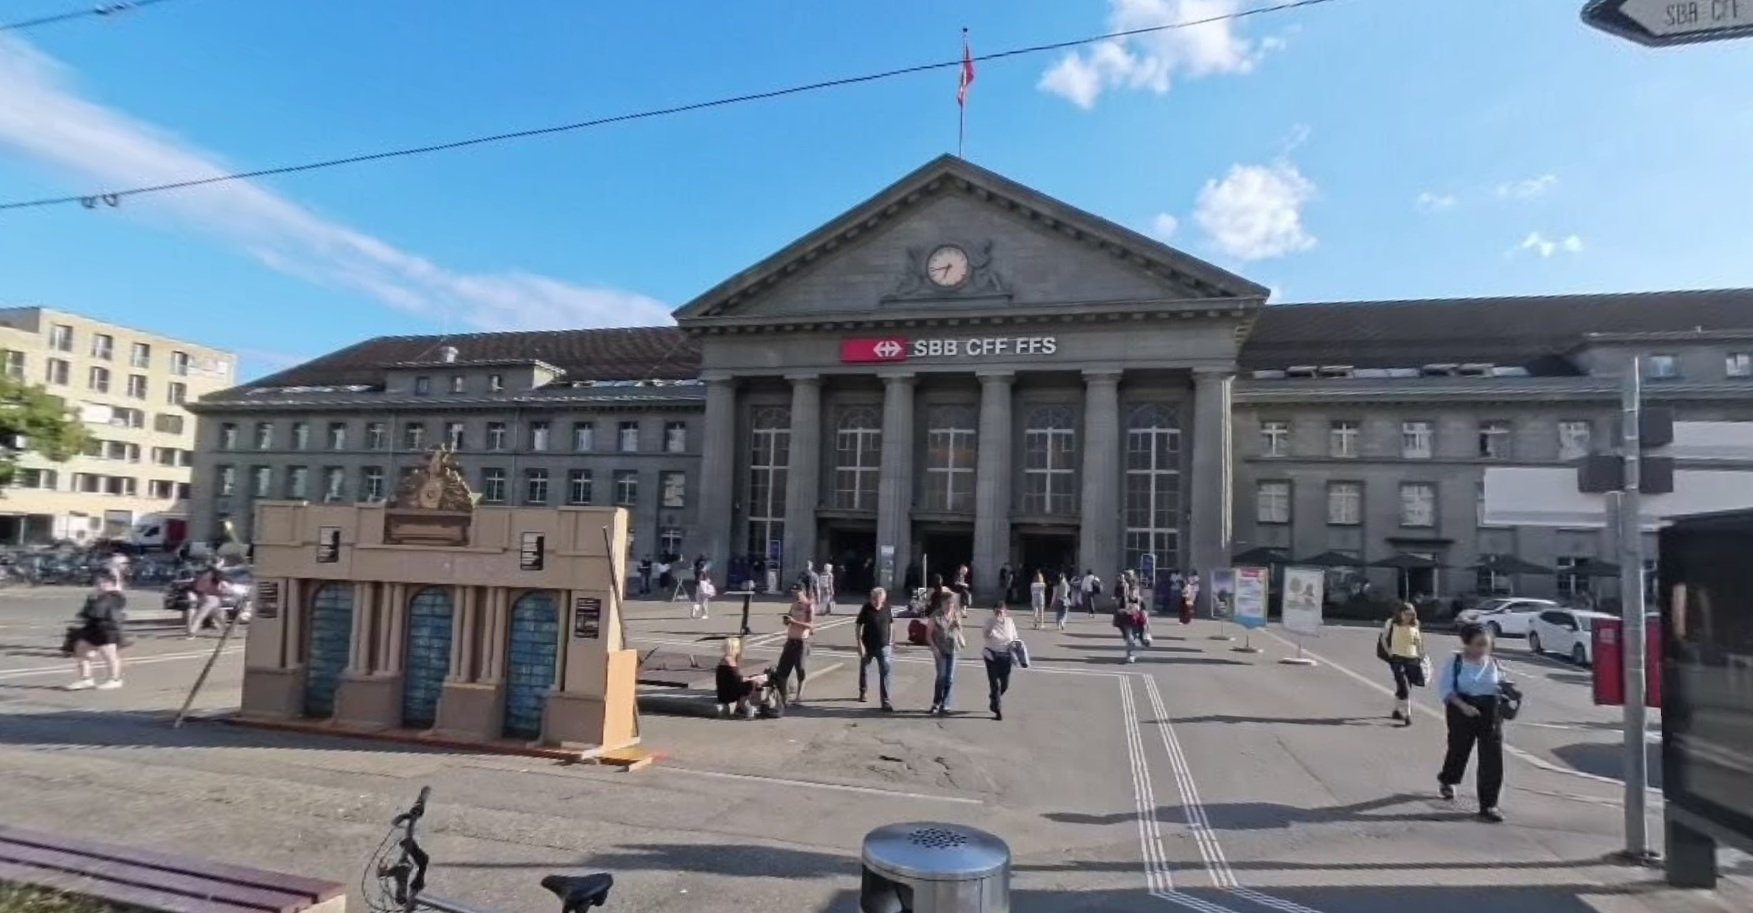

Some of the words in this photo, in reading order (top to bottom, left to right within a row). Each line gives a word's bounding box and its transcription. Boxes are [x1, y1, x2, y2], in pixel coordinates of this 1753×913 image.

[914, 339, 958, 356] SBB
[966, 337, 1008, 356] CFF
[1015, 337, 1057, 354] FFS
